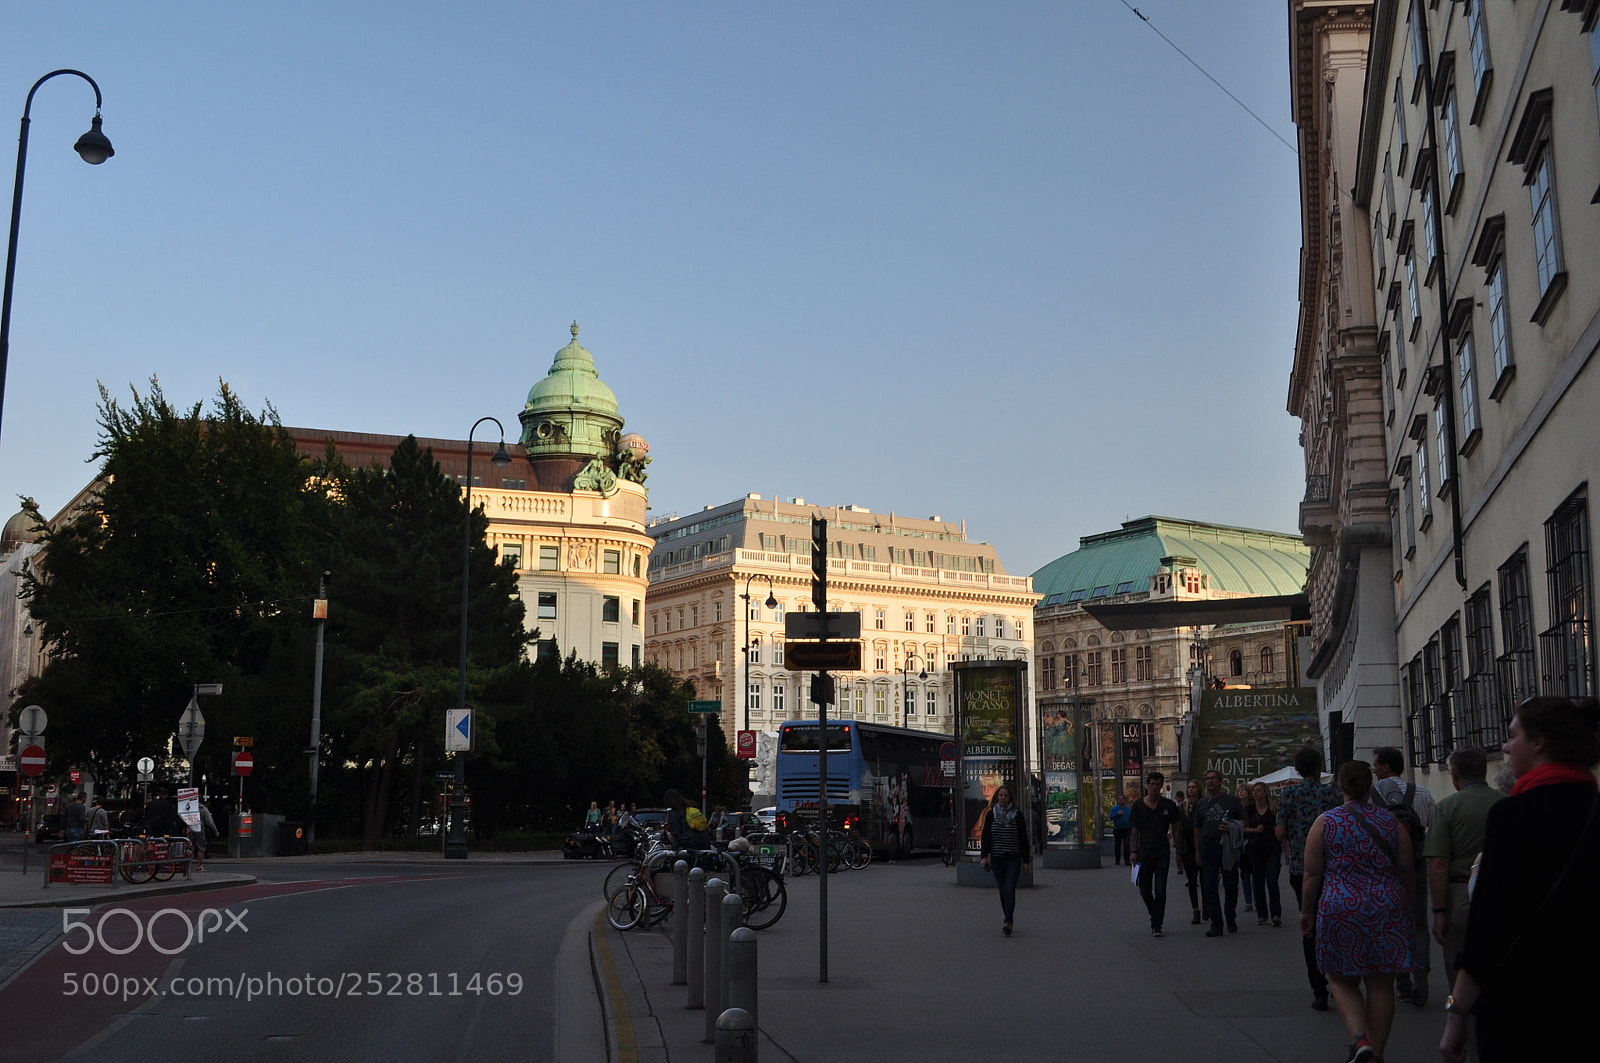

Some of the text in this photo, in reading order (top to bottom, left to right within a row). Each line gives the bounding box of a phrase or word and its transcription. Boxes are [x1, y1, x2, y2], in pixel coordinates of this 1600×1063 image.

[963, 690, 1001, 701] MONET
[1213, 694, 1300, 708] ALBERTINA
[967, 700, 1010, 711] PICASSO
[966, 745, 1013, 755] ALBERTINA
[1052, 761, 1076, 771] DEGAS
[1207, 757, 1264, 776] MONET
